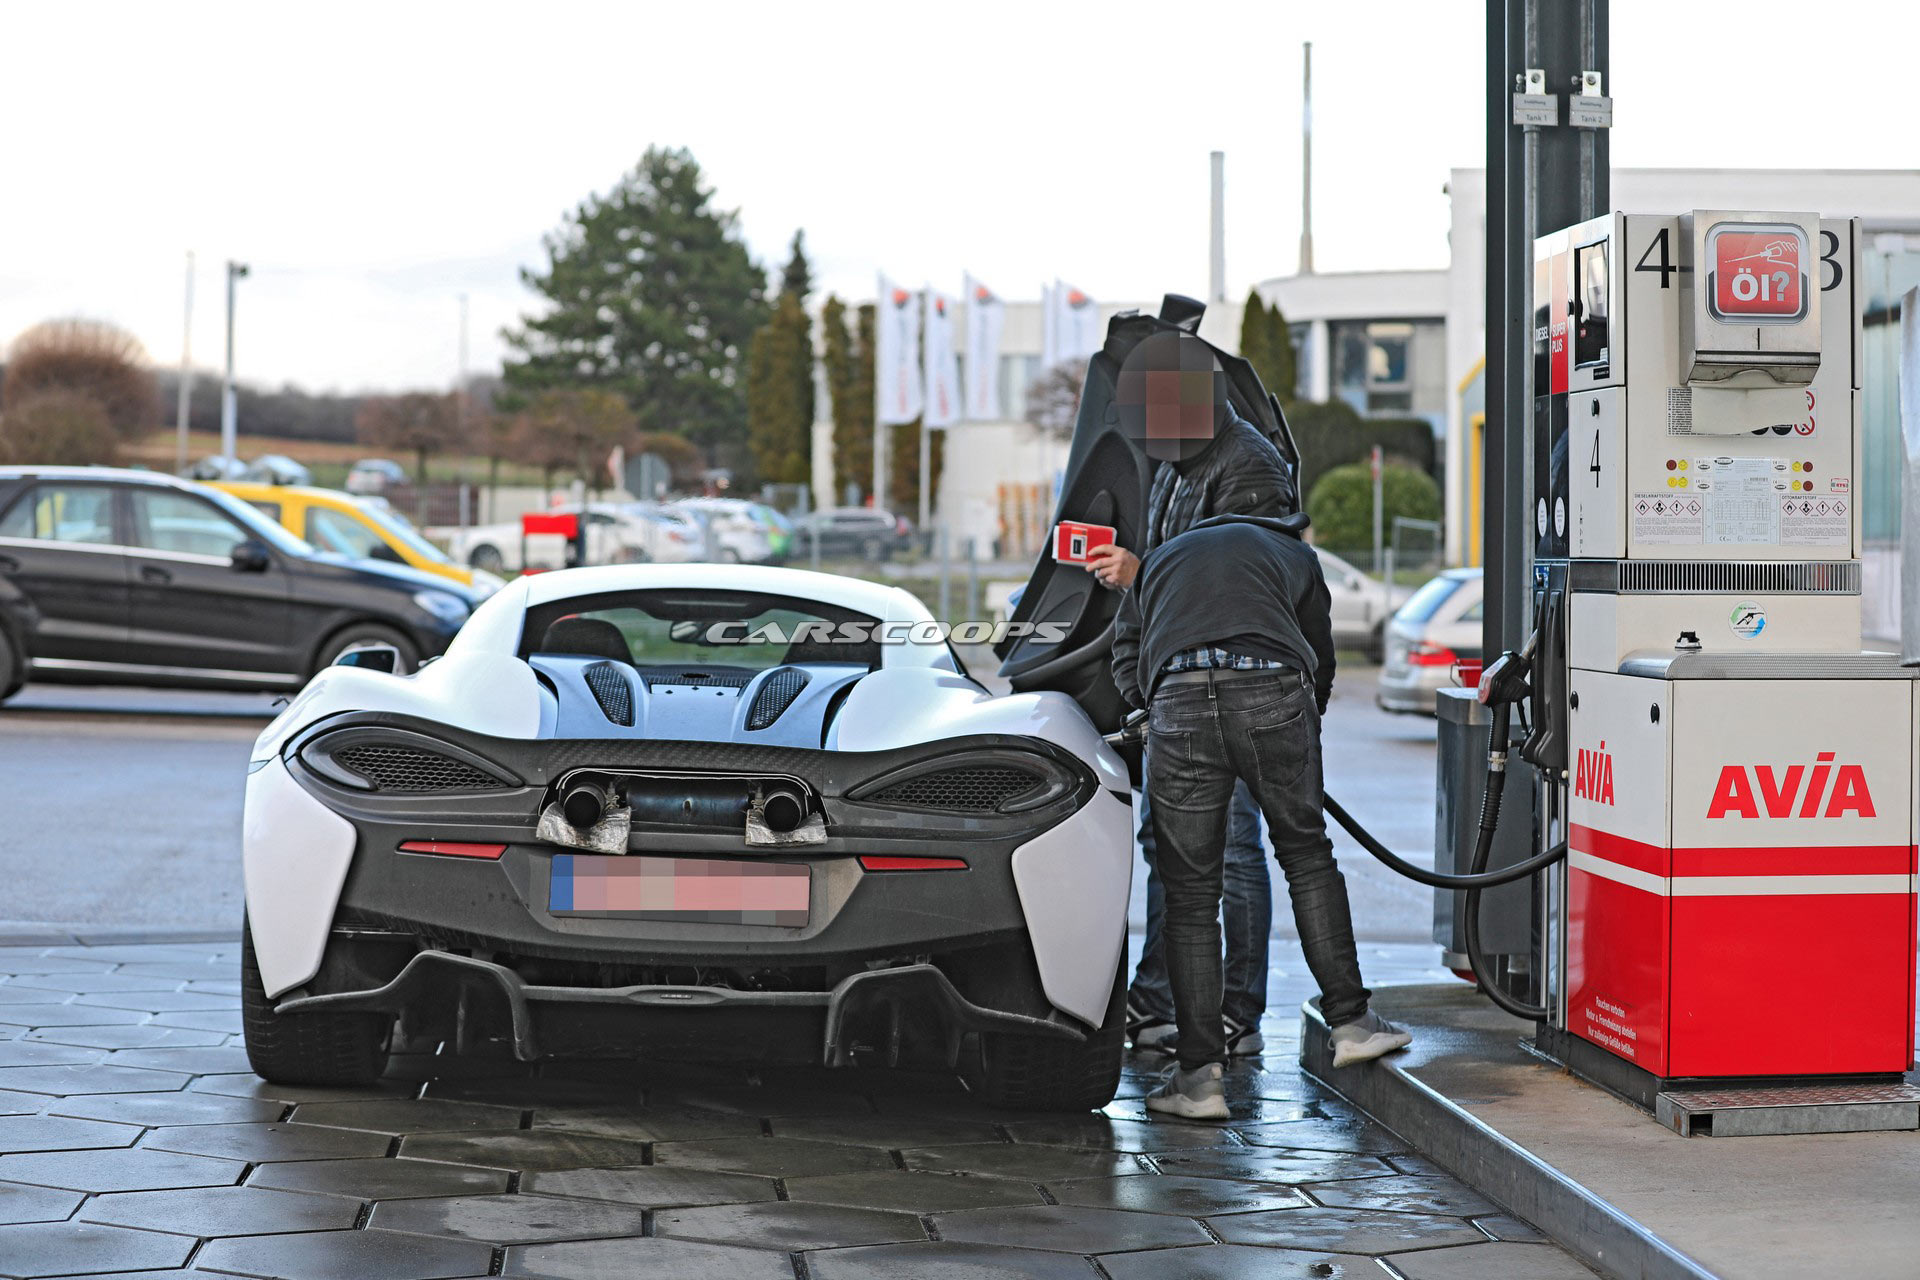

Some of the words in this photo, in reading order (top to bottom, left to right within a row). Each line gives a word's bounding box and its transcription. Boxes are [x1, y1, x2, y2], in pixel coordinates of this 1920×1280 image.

[1635, 228, 1677, 289] 4
[1731, 267, 1790, 302] Öl?
[1535, 326, 1549, 341] DIESEL
[1552, 322, 1566, 338] SUPER
[1552, 338, 1563, 353] PLUS
[1590, 429, 1601, 488] 4
[1586, 1007, 1595, 1020] Motor
[1596, 995, 1610, 1011] Rauchen
[1611, 1004, 1625, 1018] verboten
